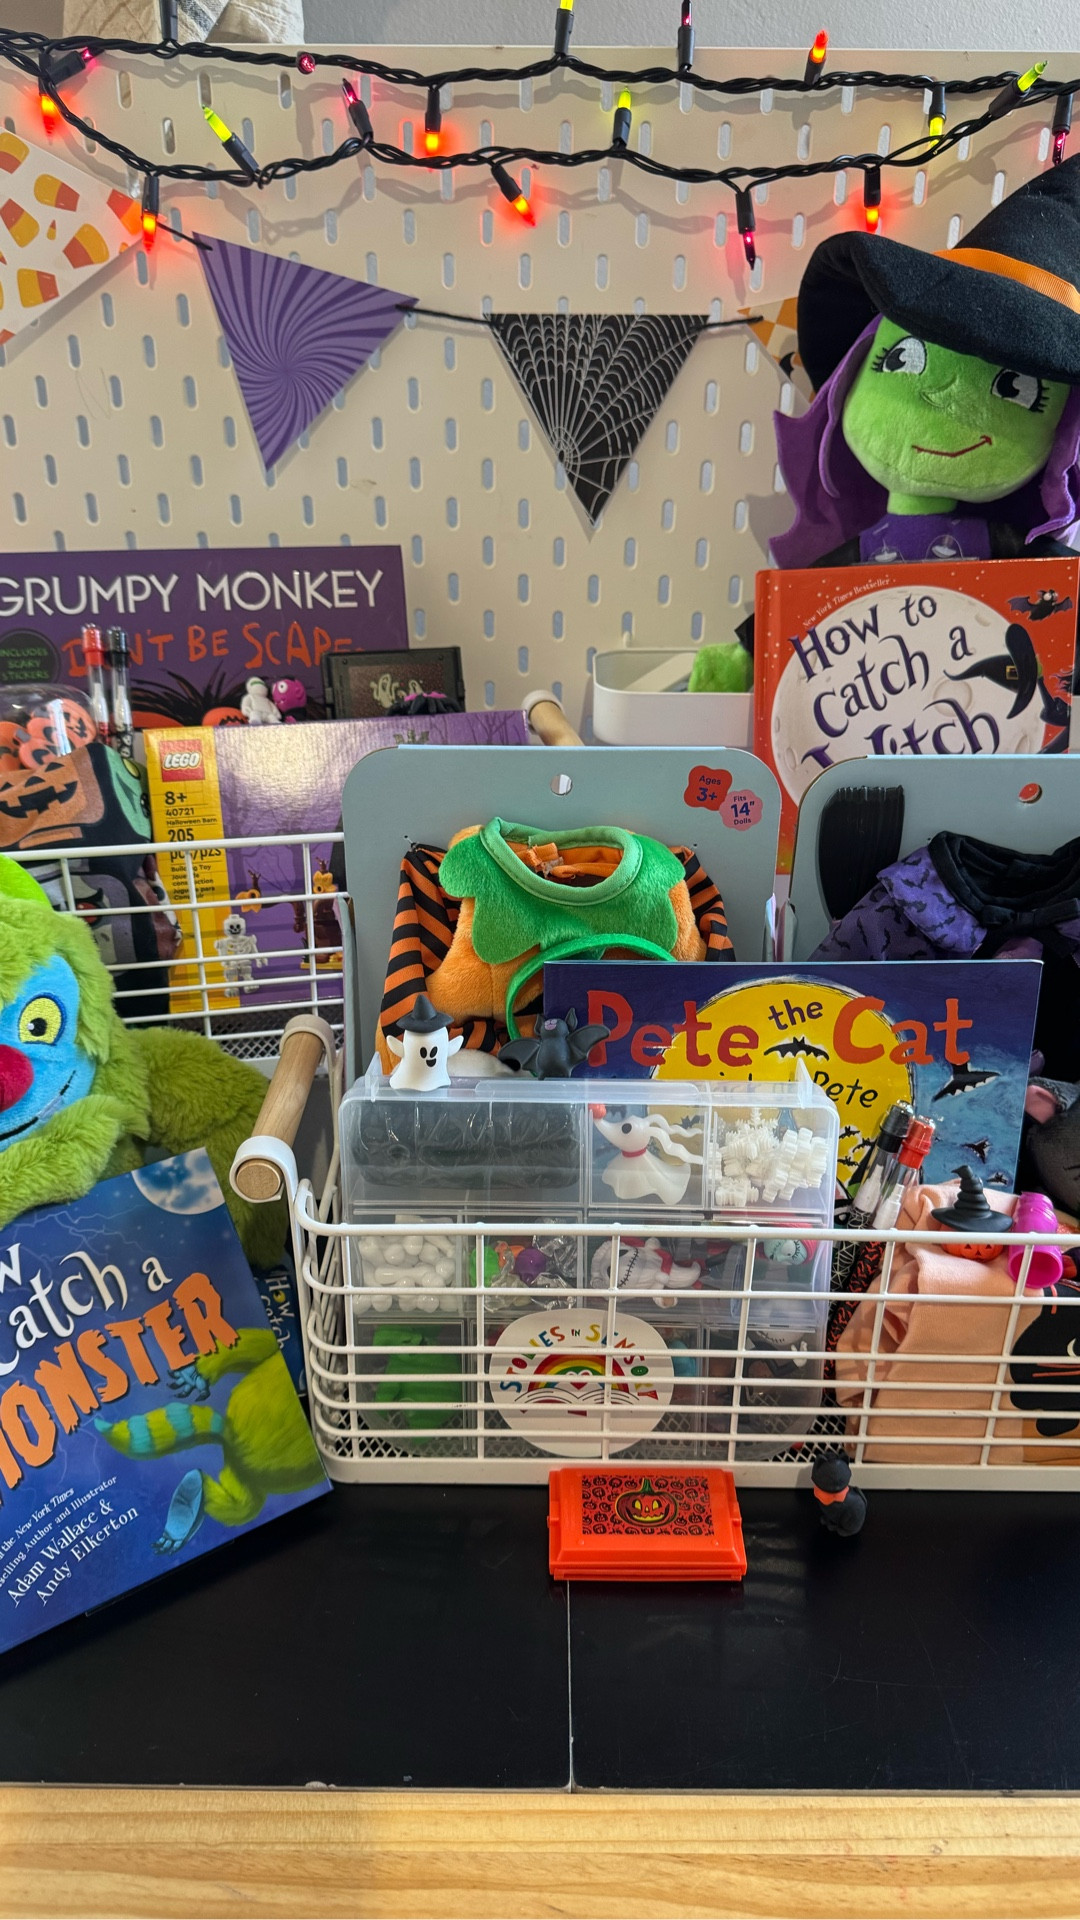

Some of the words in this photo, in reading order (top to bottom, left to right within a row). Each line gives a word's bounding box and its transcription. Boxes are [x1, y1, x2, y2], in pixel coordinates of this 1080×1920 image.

[0, 574, 179, 618] GRUMPY
[197, 569, 383, 612] MONKEY
[853, 578, 890, 595] Bestseller
[61, 627, 175, 677] DN'T
[187, 624, 229, 663] BE
[242, 621, 365, 668] SCAR
[788, 604, 880, 683] How
[899, 593, 938, 627] to
[8, 660, 41, 669] SCARY
[812, 634, 930, 738] Catch
[949, 625, 975, 661] a
[163, 751, 202, 769] LEGO
[697, 787, 717, 802] 3+
[699, 775, 721, 785] Ages
[164, 790, 187, 805] 8+
[166, 807, 195, 817] 40721
[731, 801, 755, 818] 14"
[168, 827, 195, 843] 205
[733, 818, 752, 826] Dolls
[170, 848, 222, 863] pc/pzs
[587, 990, 759, 1067] Pete
[768, 1000, 823, 1031] the
[833, 996, 973, 1066] Cat
[802, 1070, 878, 1108] Pete
[0, 1251, 128, 1376] atch
[141, 1256, 173, 1293] a
[571, 1328, 581, 1337] IN
[1, 1537, 17, 1552] the
[15, 1518, 33, 1539] New
[31, 1502, 53, 1523] York
[50, 1487, 75, 1508] Times
[24, 1522, 53, 1553] Author
[54, 1506, 72, 1525] and
[70, 1475, 118, 1511] Illustrator
[7, 1560, 47, 1609] Adam
[40, 1510, 99, 1561] Wallace
[98, 1498, 114, 1516] &
[36, 1560, 72, 1608] Andy
[69, 1506, 139, 1563] Elkerton
